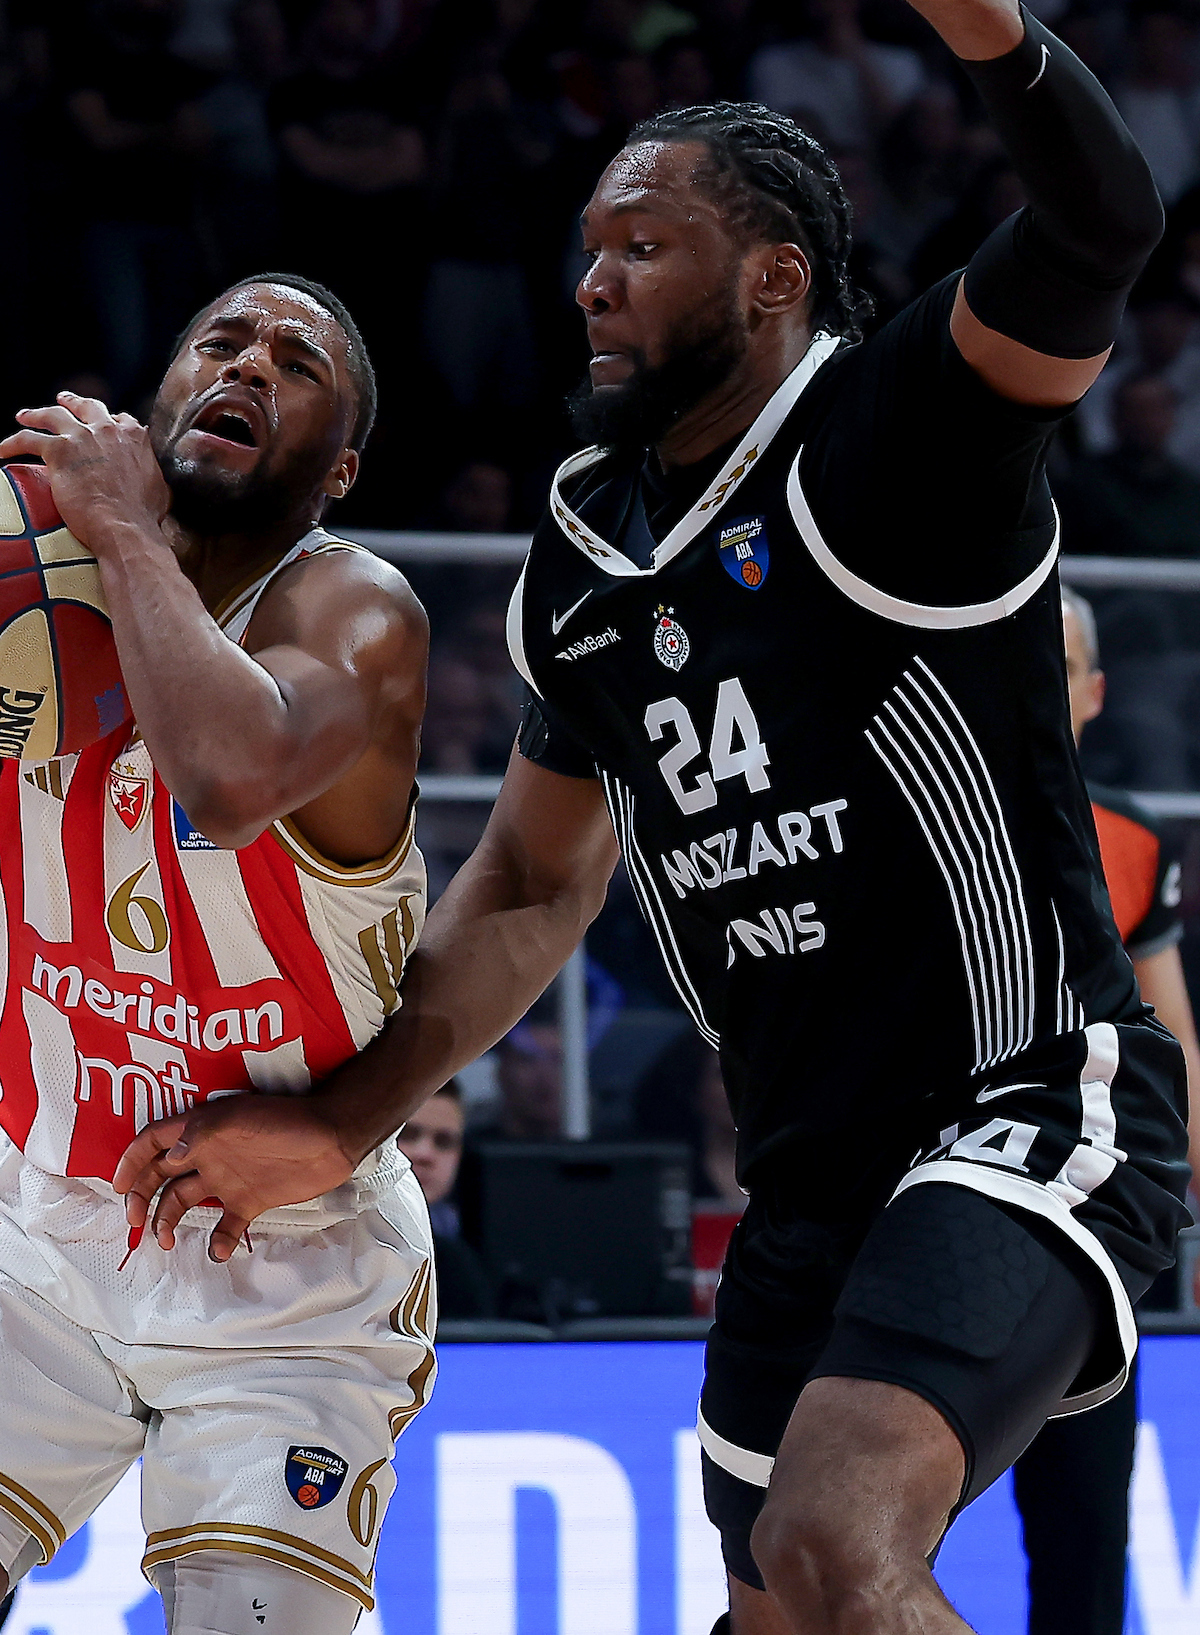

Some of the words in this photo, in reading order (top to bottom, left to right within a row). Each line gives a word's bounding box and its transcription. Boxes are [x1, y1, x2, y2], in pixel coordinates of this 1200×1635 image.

[720, 517, 763, 541] ADMIRAL
[734, 540, 755, 561] ABA
[567, 626, 622, 660] AikBank
[643, 676, 771, 816] 24
[660, 798, 849, 899] MOZZART
[104, 857, 171, 955] 6
[32, 952, 284, 1053] meridian
[76, 1049, 252, 1121] mt
[909, 1116, 1042, 1174] 4
[295, 1448, 345, 1472] ADMIRAL
[303, 1466, 326, 1487] ABA
[346, 1458, 389, 1548] 6
